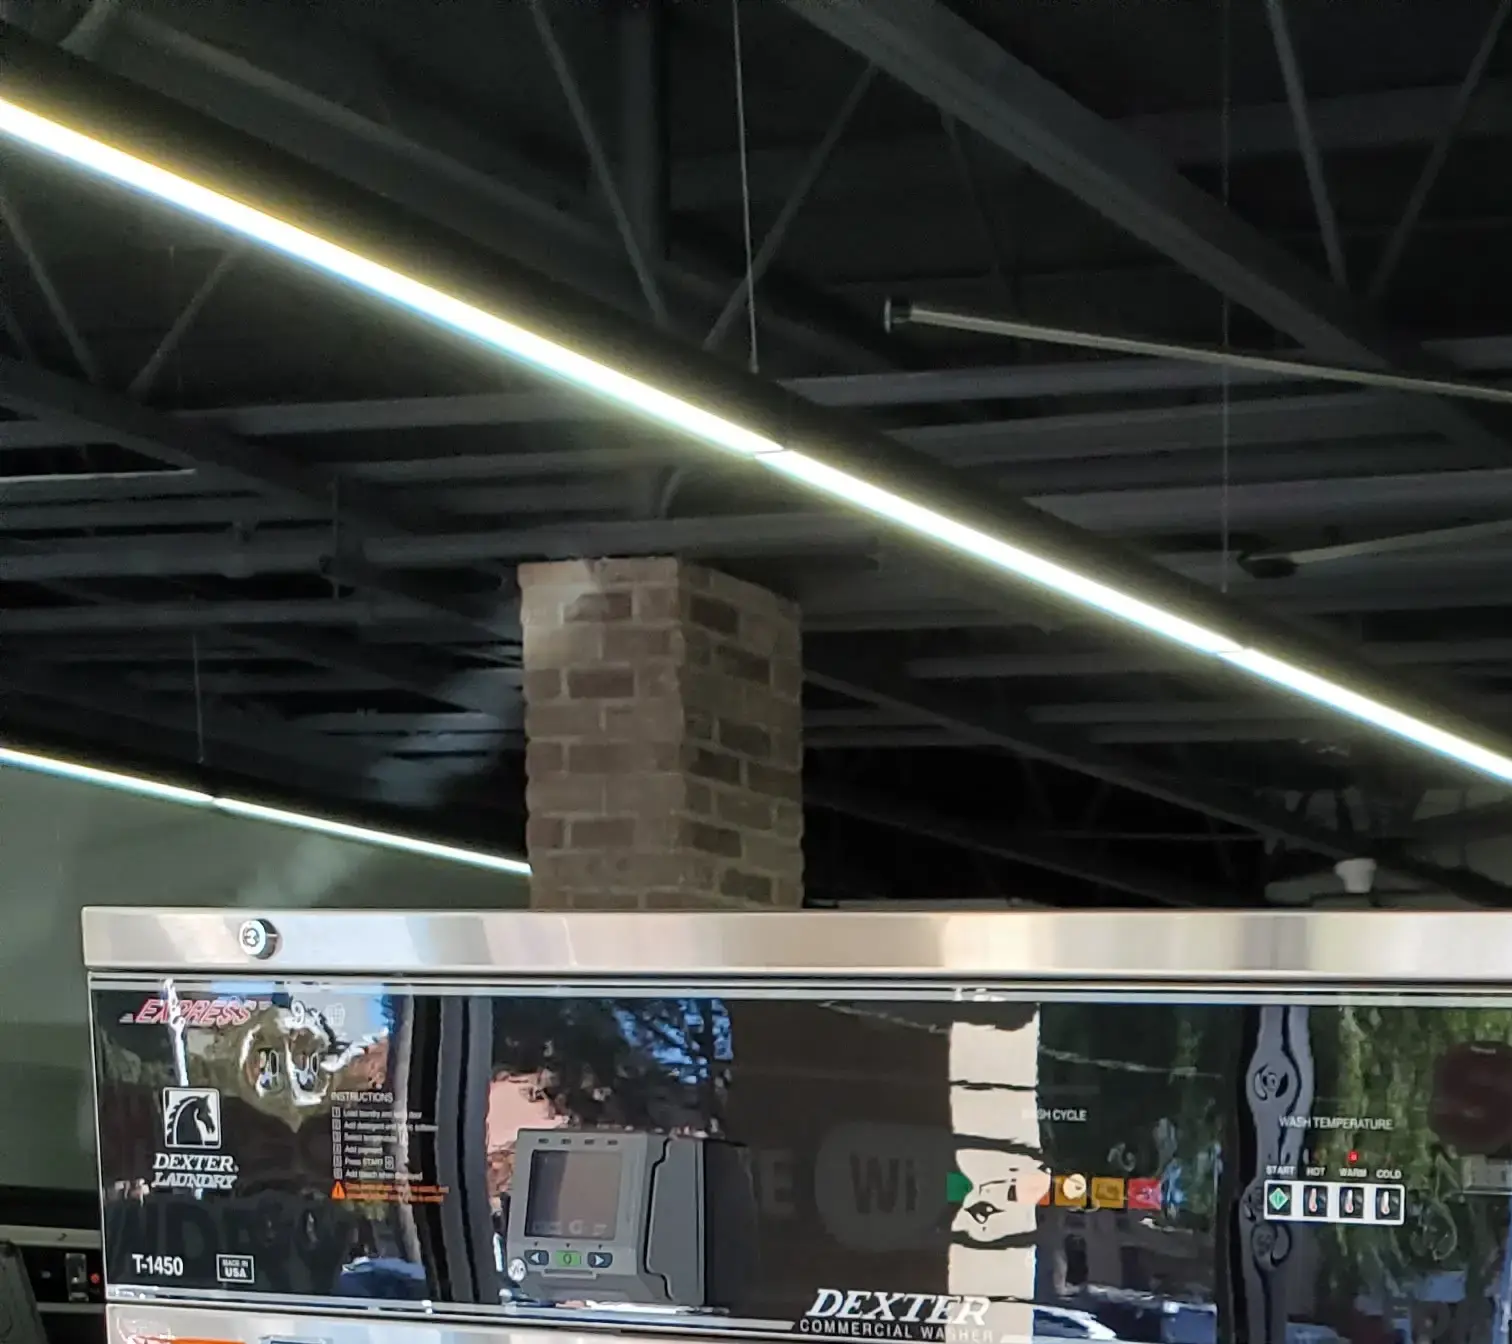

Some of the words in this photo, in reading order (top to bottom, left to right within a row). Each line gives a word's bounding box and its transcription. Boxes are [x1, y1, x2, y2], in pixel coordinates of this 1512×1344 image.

[331, 1091, 393, 1104] INSTRUCTIONS
[1052, 1108, 1088, 1121] CYCLE
[1279, 1115, 1311, 1128] WASH
[1313, 1116, 1394, 1131] TEMPERATURE
[152, 1153, 235, 1173] DEXTER
[1266, 1165, 1296, 1175] START
[1306, 1166, 1326, 1177] HOT
[1339, 1167, 1368, 1178] WARM
[1376, 1168, 1402, 1180] COLD
[152, 1172, 237, 1189] LAUNDRY
[132, 1253, 184, 1276] T-1450
[225, 1267, 247, 1279] USA
[805, 1288, 992, 1326] DEXTER
[800, 1318, 913, 1339] COMMERCIAL
[920, 1325, 994, 1344] WASHER
